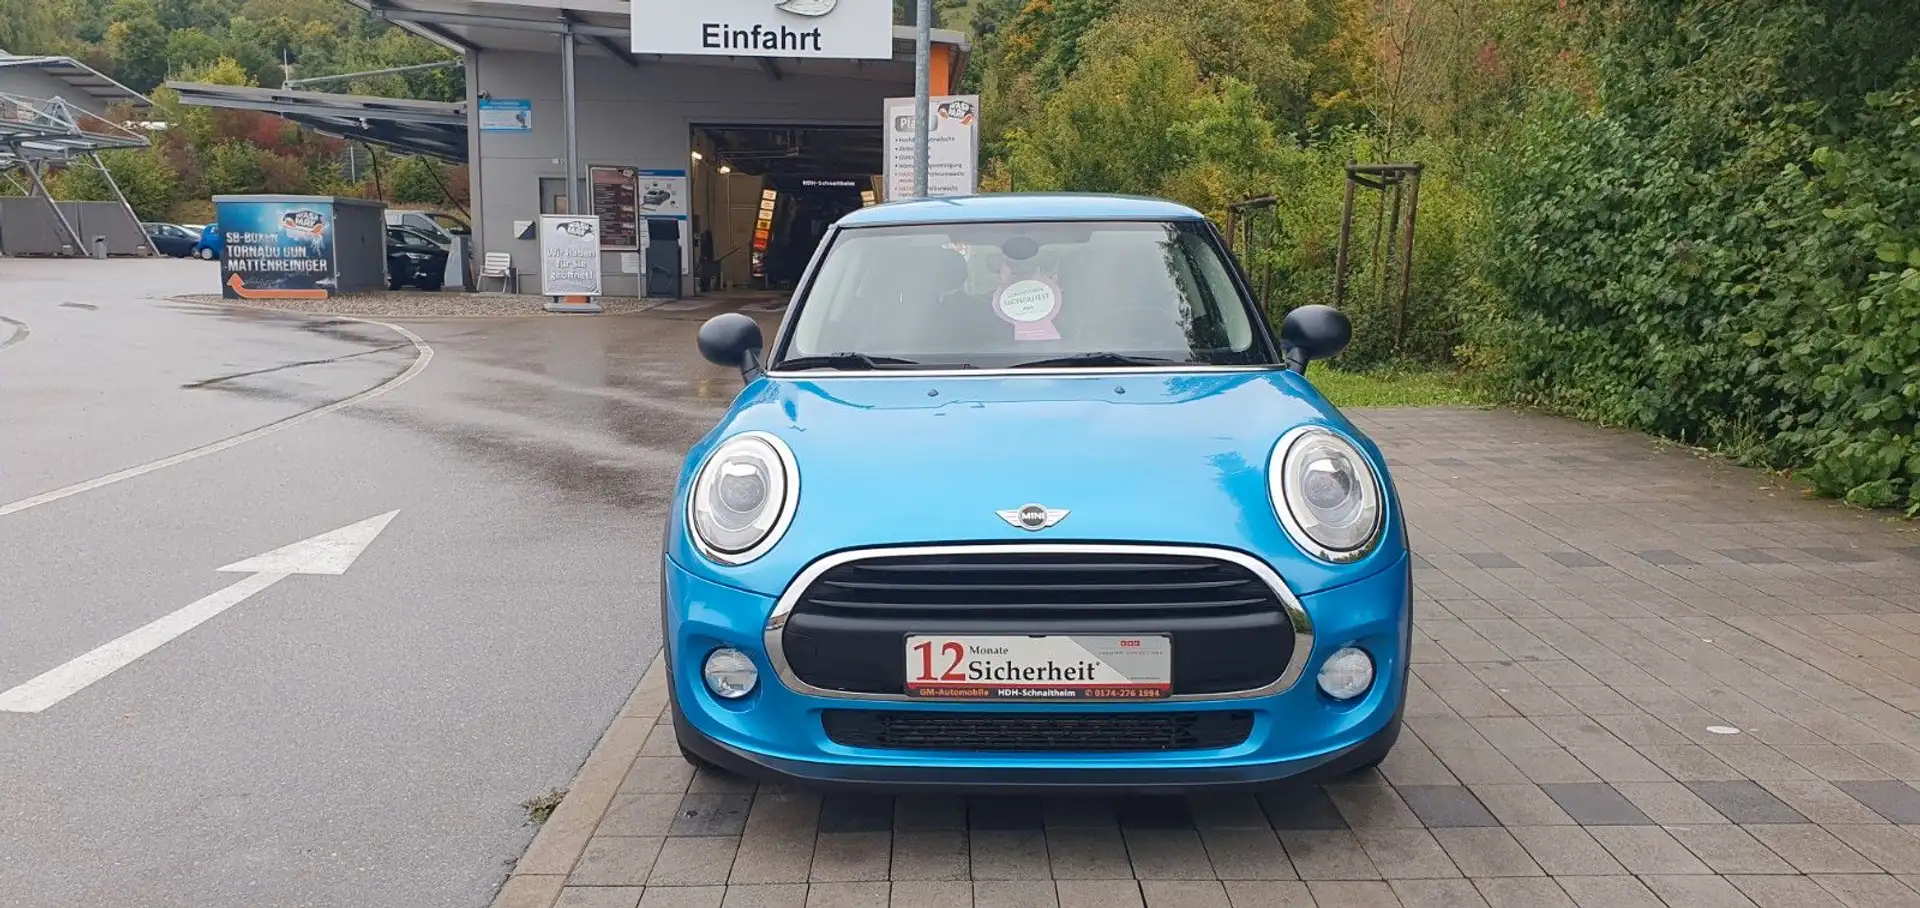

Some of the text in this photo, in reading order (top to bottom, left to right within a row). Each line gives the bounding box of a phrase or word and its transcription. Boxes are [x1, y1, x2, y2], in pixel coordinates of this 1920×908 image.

[702, 23, 822, 51] Einfahrt
[226, 245, 307, 258] TORNADO GUN
[547, 248, 563, 257] Wir
[227, 260, 328, 272] MATTENREINIGER
[1022, 512, 1045, 520] MINI
[913, 641, 1009, 681] 12 Monate
[919, 688, 1160, 697] GM-Automobile HDH-Schnaitheim 0174-276 1994
